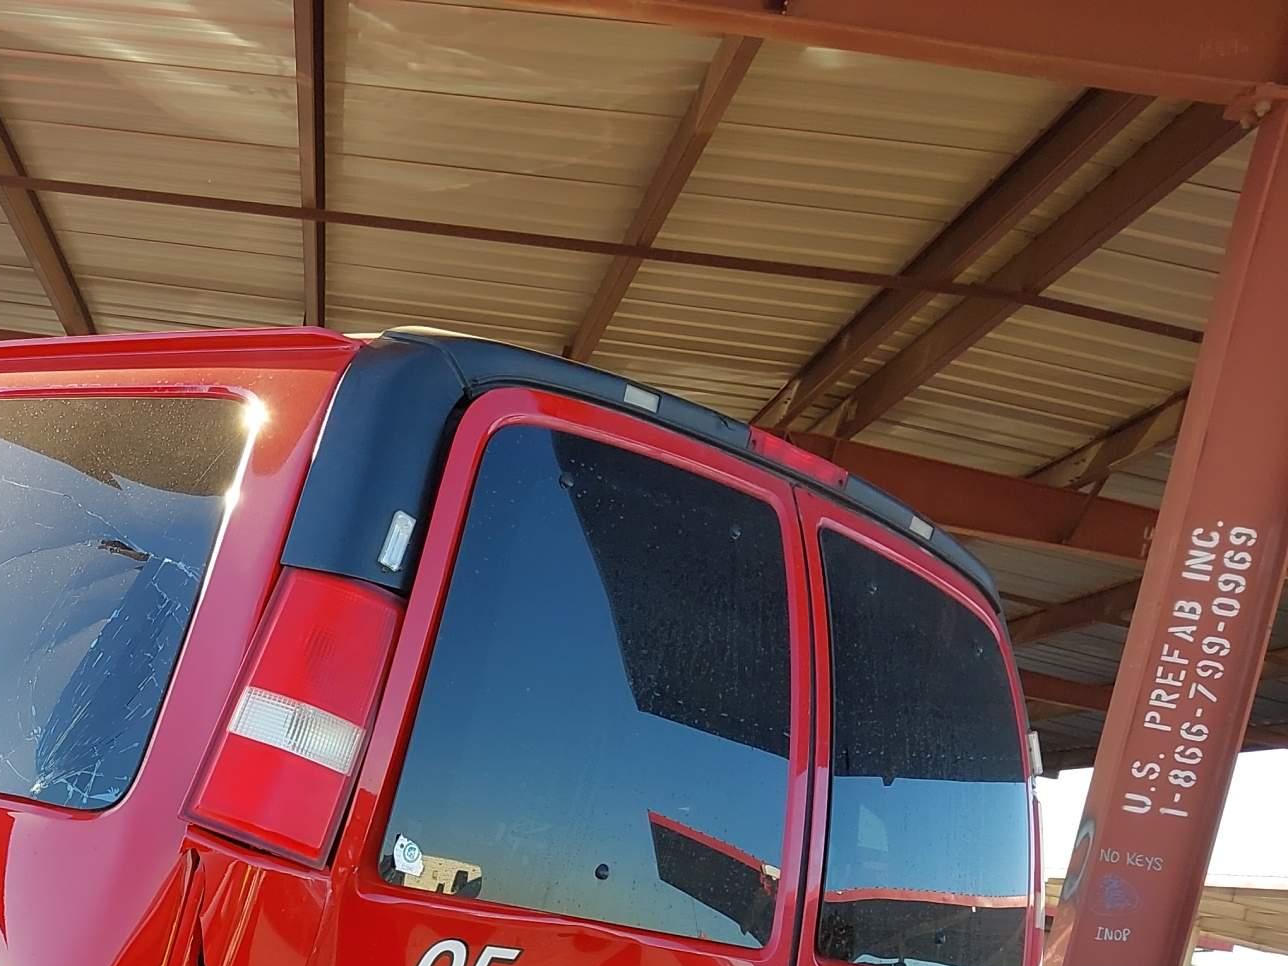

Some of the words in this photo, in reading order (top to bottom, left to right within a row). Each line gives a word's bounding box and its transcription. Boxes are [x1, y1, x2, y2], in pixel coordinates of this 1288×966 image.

[1181, 520, 1224, 582] INC.
[1143, 600, 1202, 732] PREFAB
[1159, 526, 1258, 817] 1-866-799-0969
[1122, 753, 1165, 814] U.S.
[1099, 847, 1121, 863] NO
[1126, 851, 1164, 871] KEYS
[1094, 926, 1132, 942] INOP
